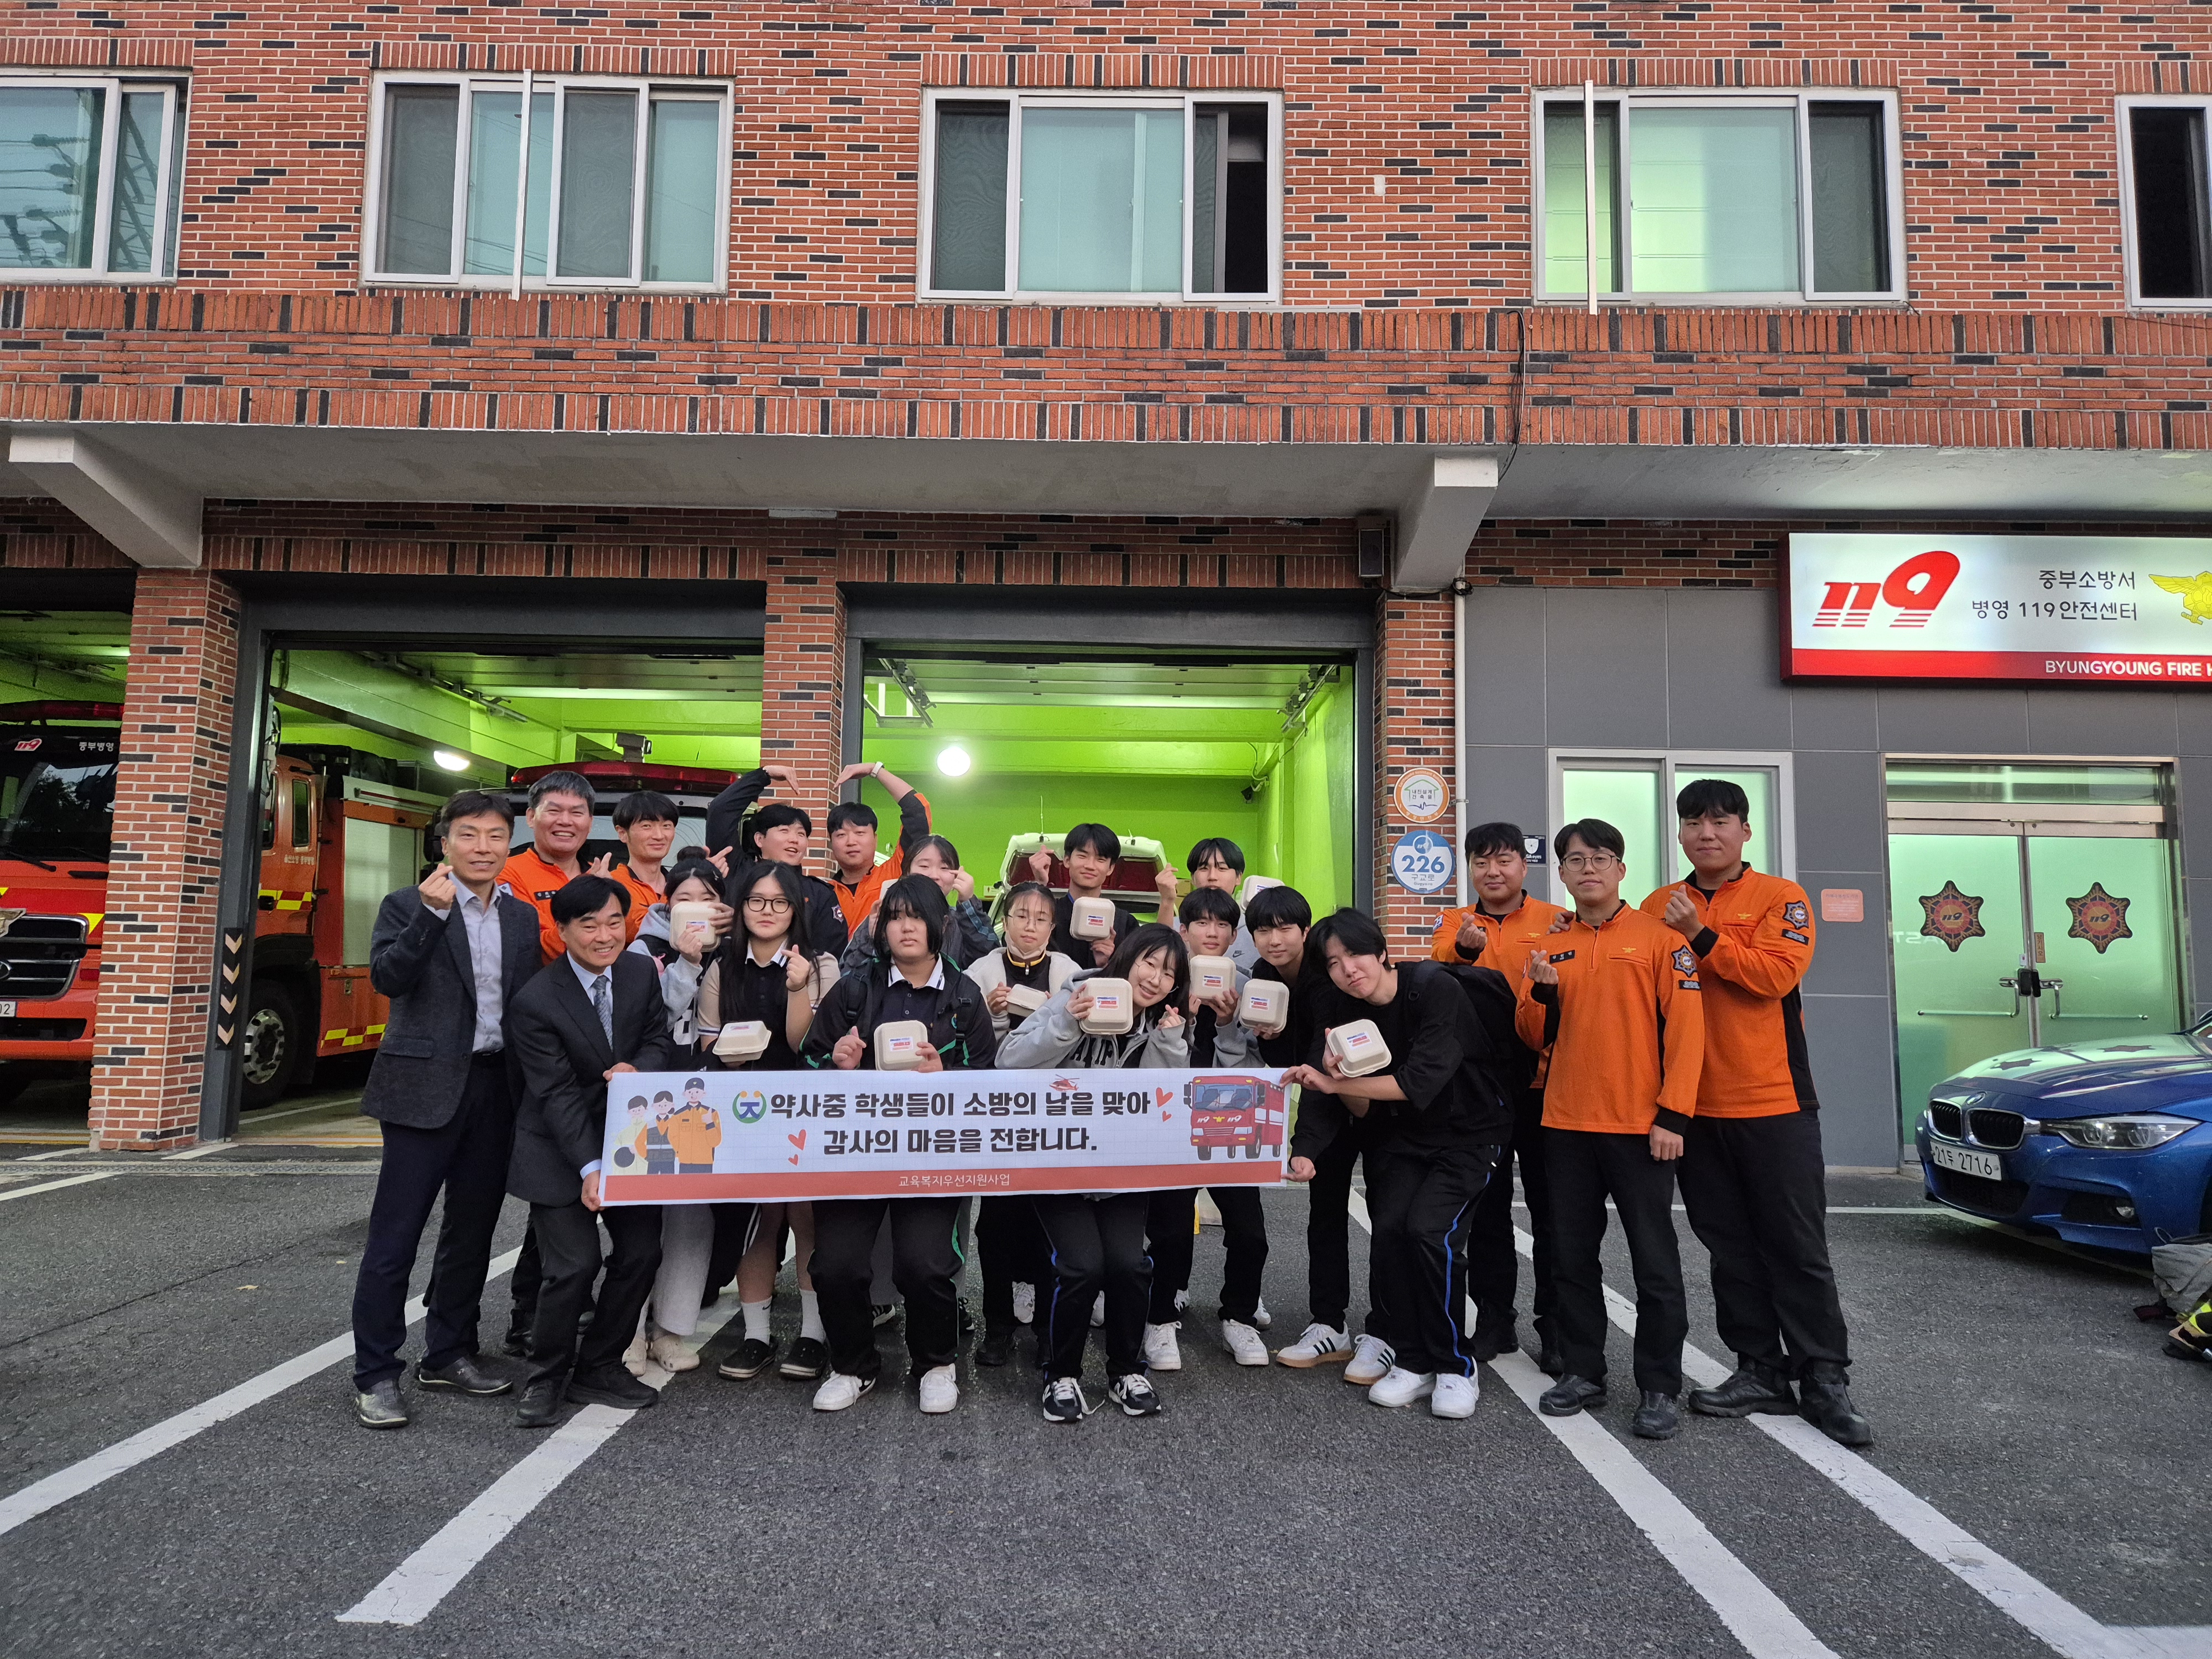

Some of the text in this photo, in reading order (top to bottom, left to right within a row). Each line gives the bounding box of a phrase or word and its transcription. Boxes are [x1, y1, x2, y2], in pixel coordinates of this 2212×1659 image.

[1812, 550, 1961, 628] 119
[2038, 570, 2136, 590] 중부소방서
[1971, 600, 2137, 621] 병영 119안전센터
[2045, 660, 2162, 676] BYUNGYOUNG
[2167, 661, 2202, 676] FIRE
[15, 738, 42, 750] 119
[79, 742, 114, 752] 중부병영
[1401, 855, 1445, 873] 226
[1942, 912, 1963, 921] 119
[2089, 914, 2110, 922] 119
[770, 1091, 1151, 1119] 약사중 학생들이 소방의 날을 맞아
[823, 1126, 1098, 1155] 감사의 마음을 전합니다.
[1958, 1152, 1992, 1175] 2716
[899, 1173, 1010, 1188] 교육복지우선지원사업
